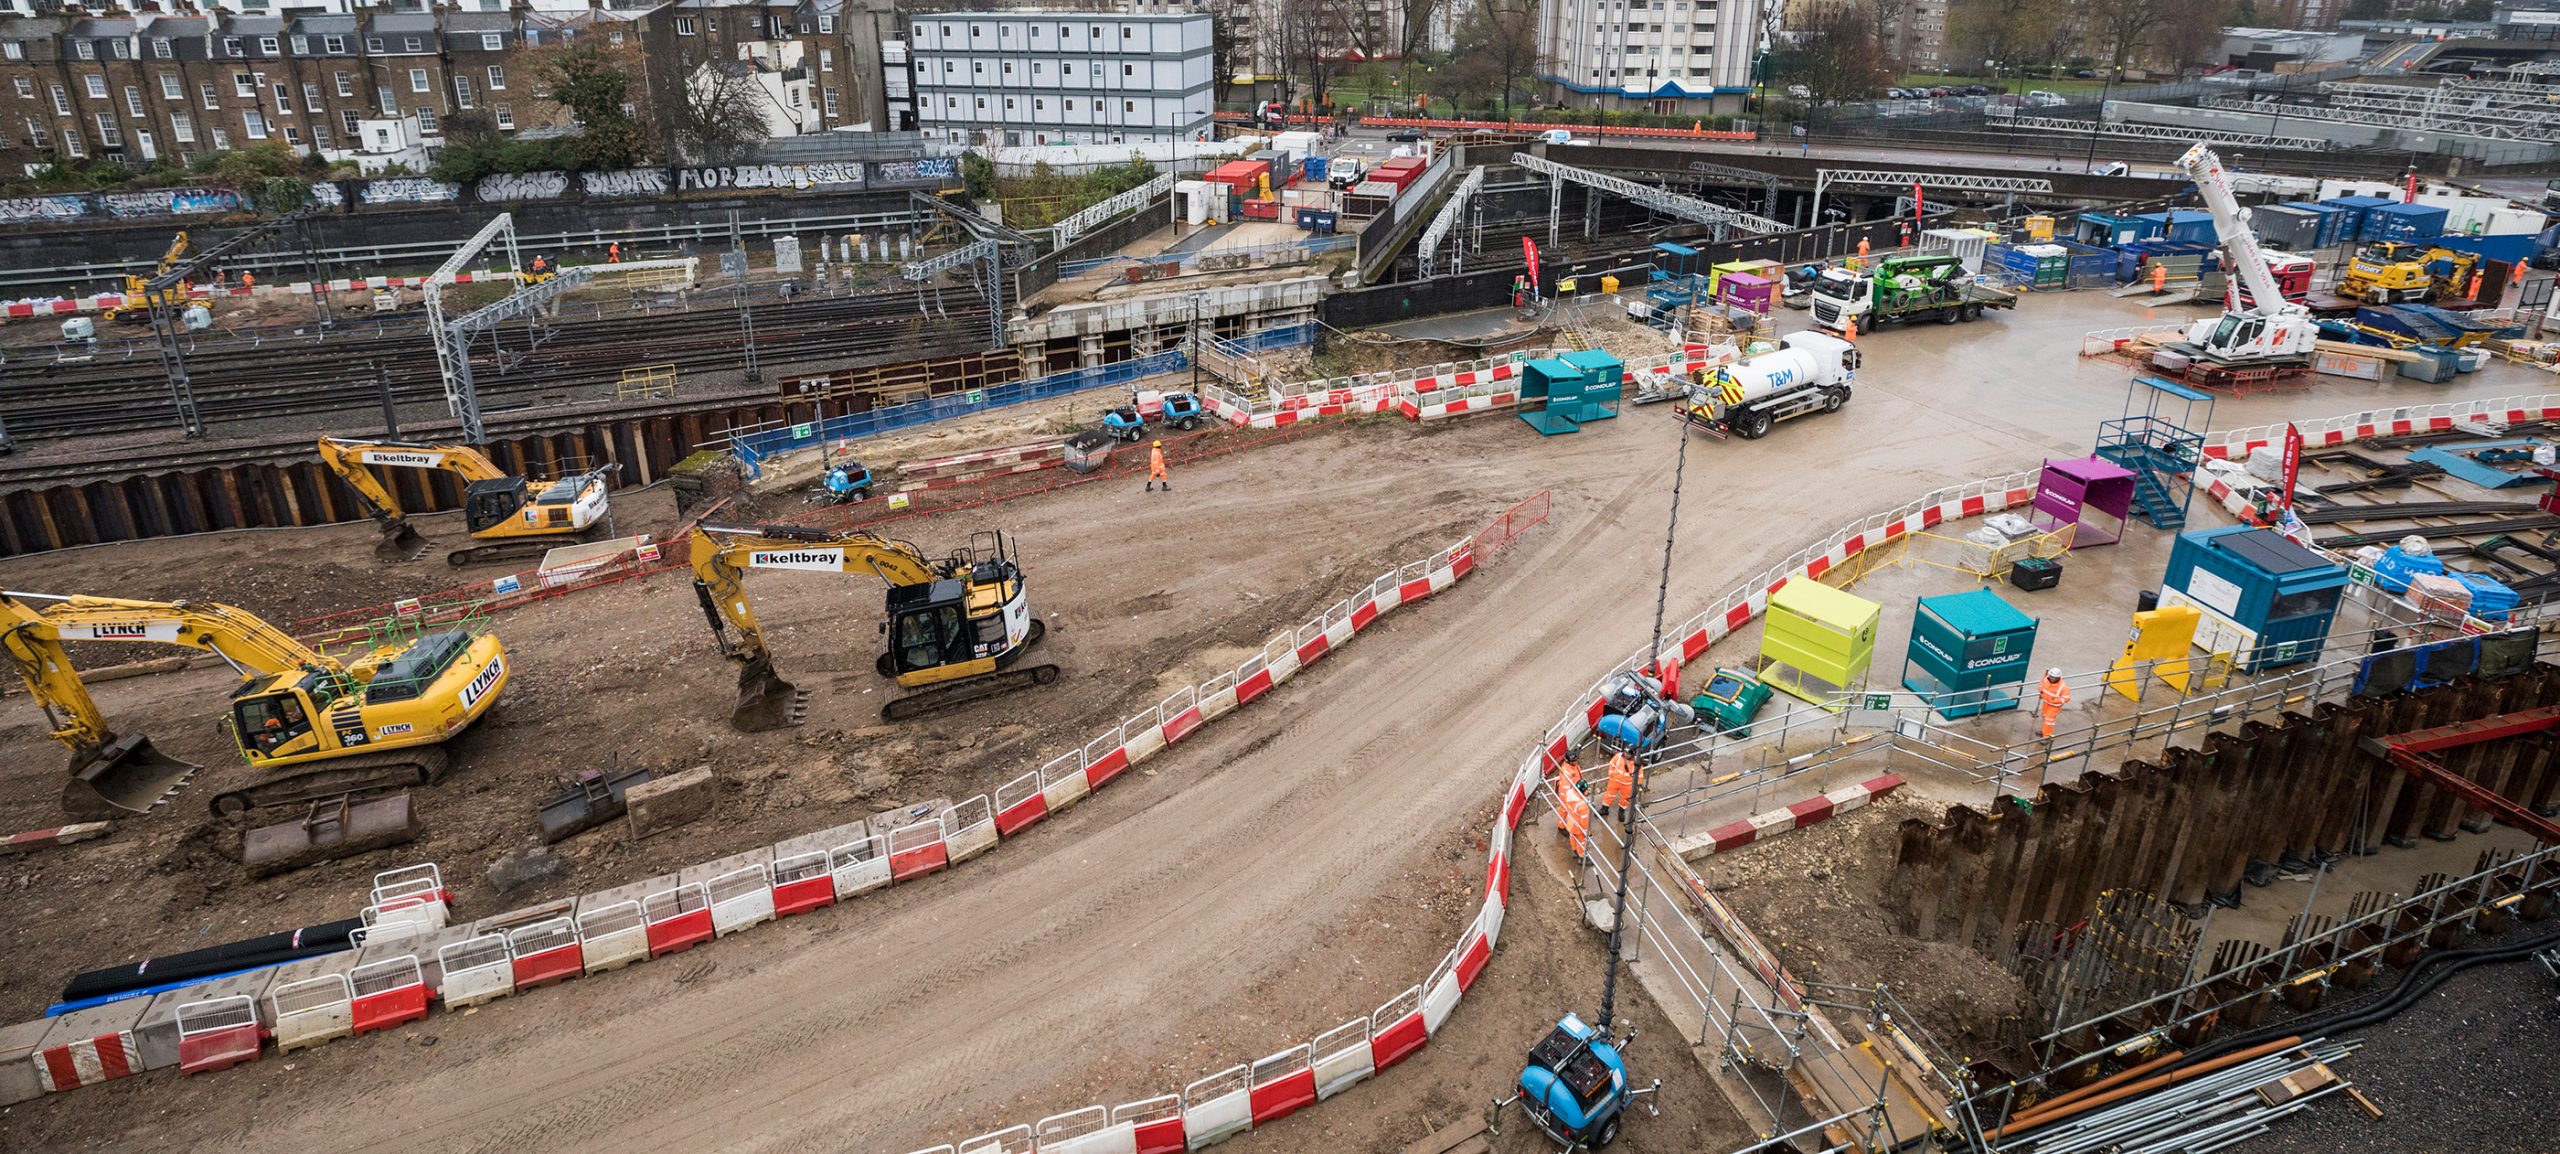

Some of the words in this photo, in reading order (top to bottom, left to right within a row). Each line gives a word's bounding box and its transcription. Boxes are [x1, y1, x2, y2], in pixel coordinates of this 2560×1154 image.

[2355, 263, 2382, 274] STORY
[1766, 368, 1793, 388] T&M
[2285, 435, 2296, 466] FIRE
[383, 454, 430, 464] keltbray
[770, 552, 837, 569] keltbray
[879, 560, 898, 572] 0042
[974, 643, 988, 653] CAT
[1924, 639, 1953, 662] CONQUIP
[1975, 653, 2021, 667] CONQUIP
[471, 658, 501, 695] LYNCH
[387, 723, 411, 733] LYNCH
[344, 733, 364, 742] 360
